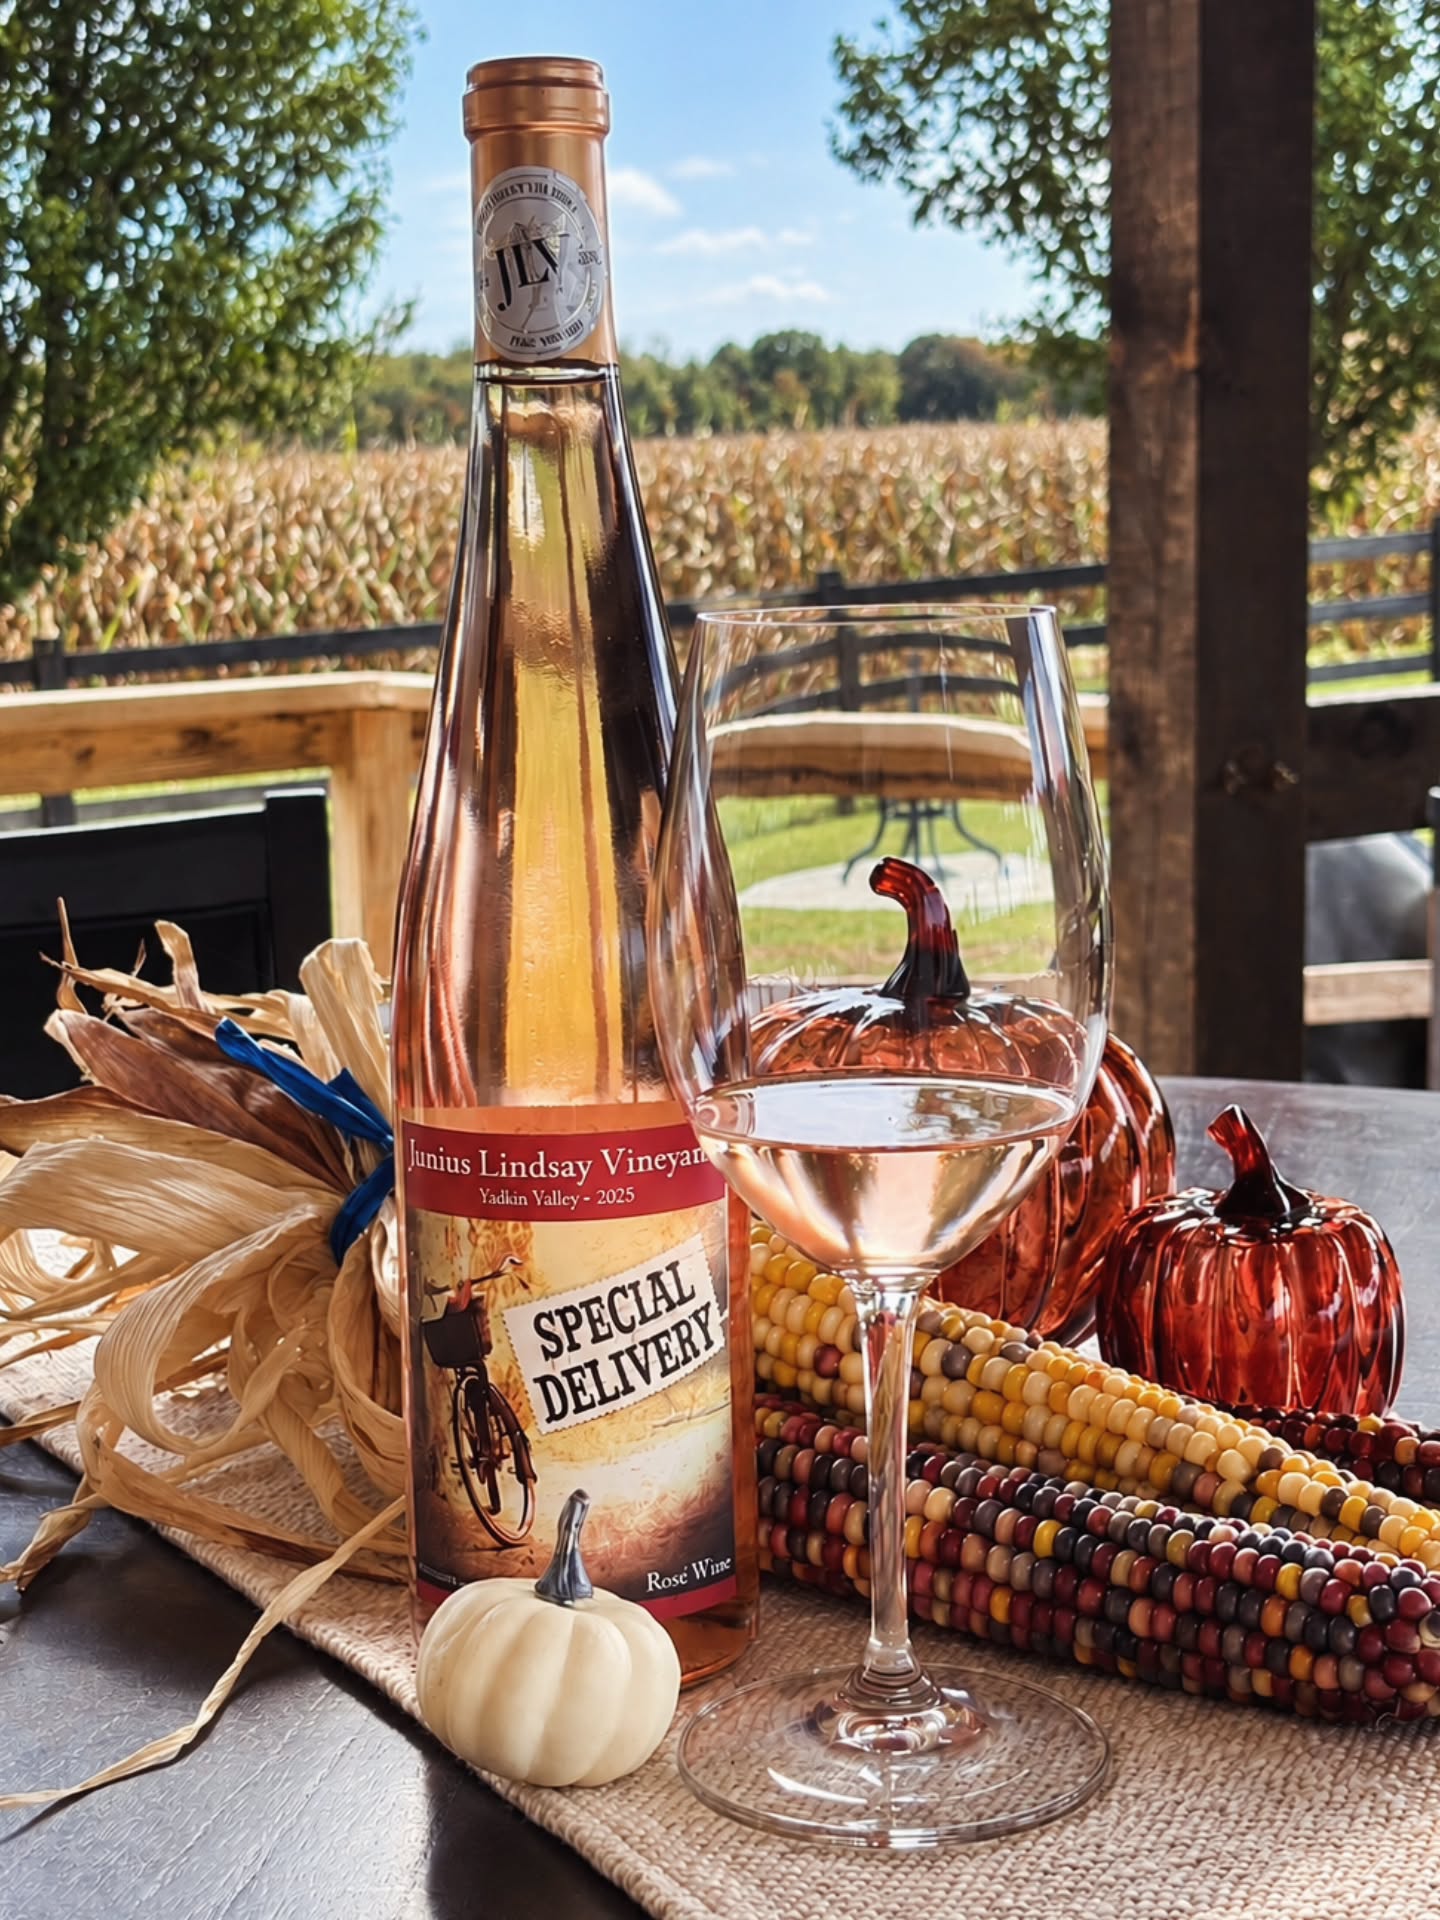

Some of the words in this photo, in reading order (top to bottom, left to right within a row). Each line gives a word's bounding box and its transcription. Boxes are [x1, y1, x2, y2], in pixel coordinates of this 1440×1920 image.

[496, 231, 570, 311] JLV
[408, 1138, 471, 1175] Junius
[479, 1150, 593, 1186] Lindsay
[479, 1187, 528, 1206] Yadkin
[532, 1189, 580, 1210] Valley
[596, 1187, 635, 1205] 2025
[533, 1260, 696, 1361] SPECIAL
[533, 1302, 714, 1424] DELIVERY
[646, 1566, 688, 1593] Rosé
[691, 1557, 732, 1580] Wine
